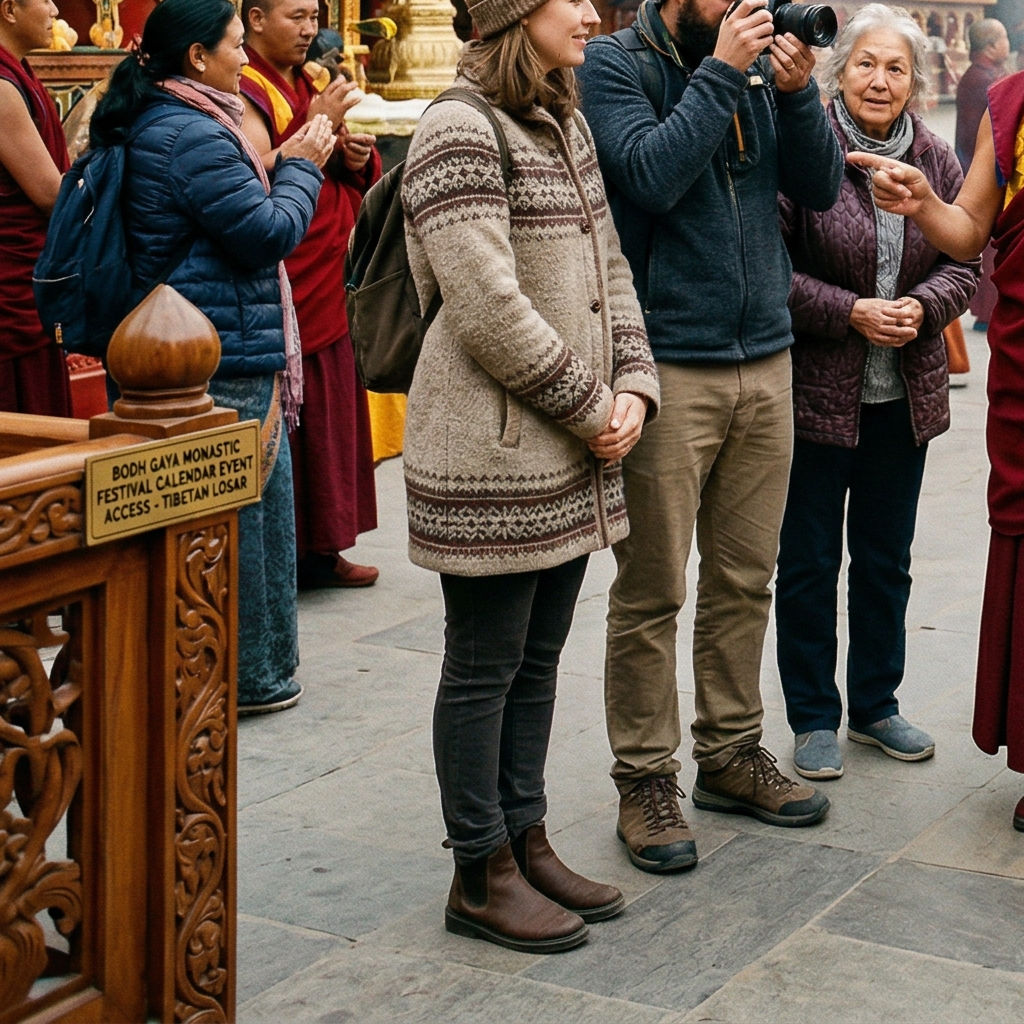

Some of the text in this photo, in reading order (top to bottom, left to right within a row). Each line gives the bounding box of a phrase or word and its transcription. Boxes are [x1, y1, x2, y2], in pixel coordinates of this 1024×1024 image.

[97, 455, 253, 506] FESTIVAL CALENDAR EVENT
[112, 439, 240, 481] BODH GAYA MONASTIC
[104, 499, 151, 524] ACCESS
[162, 485, 209, 509] TIBETAN
[213, 475, 247, 497] LOSAR
